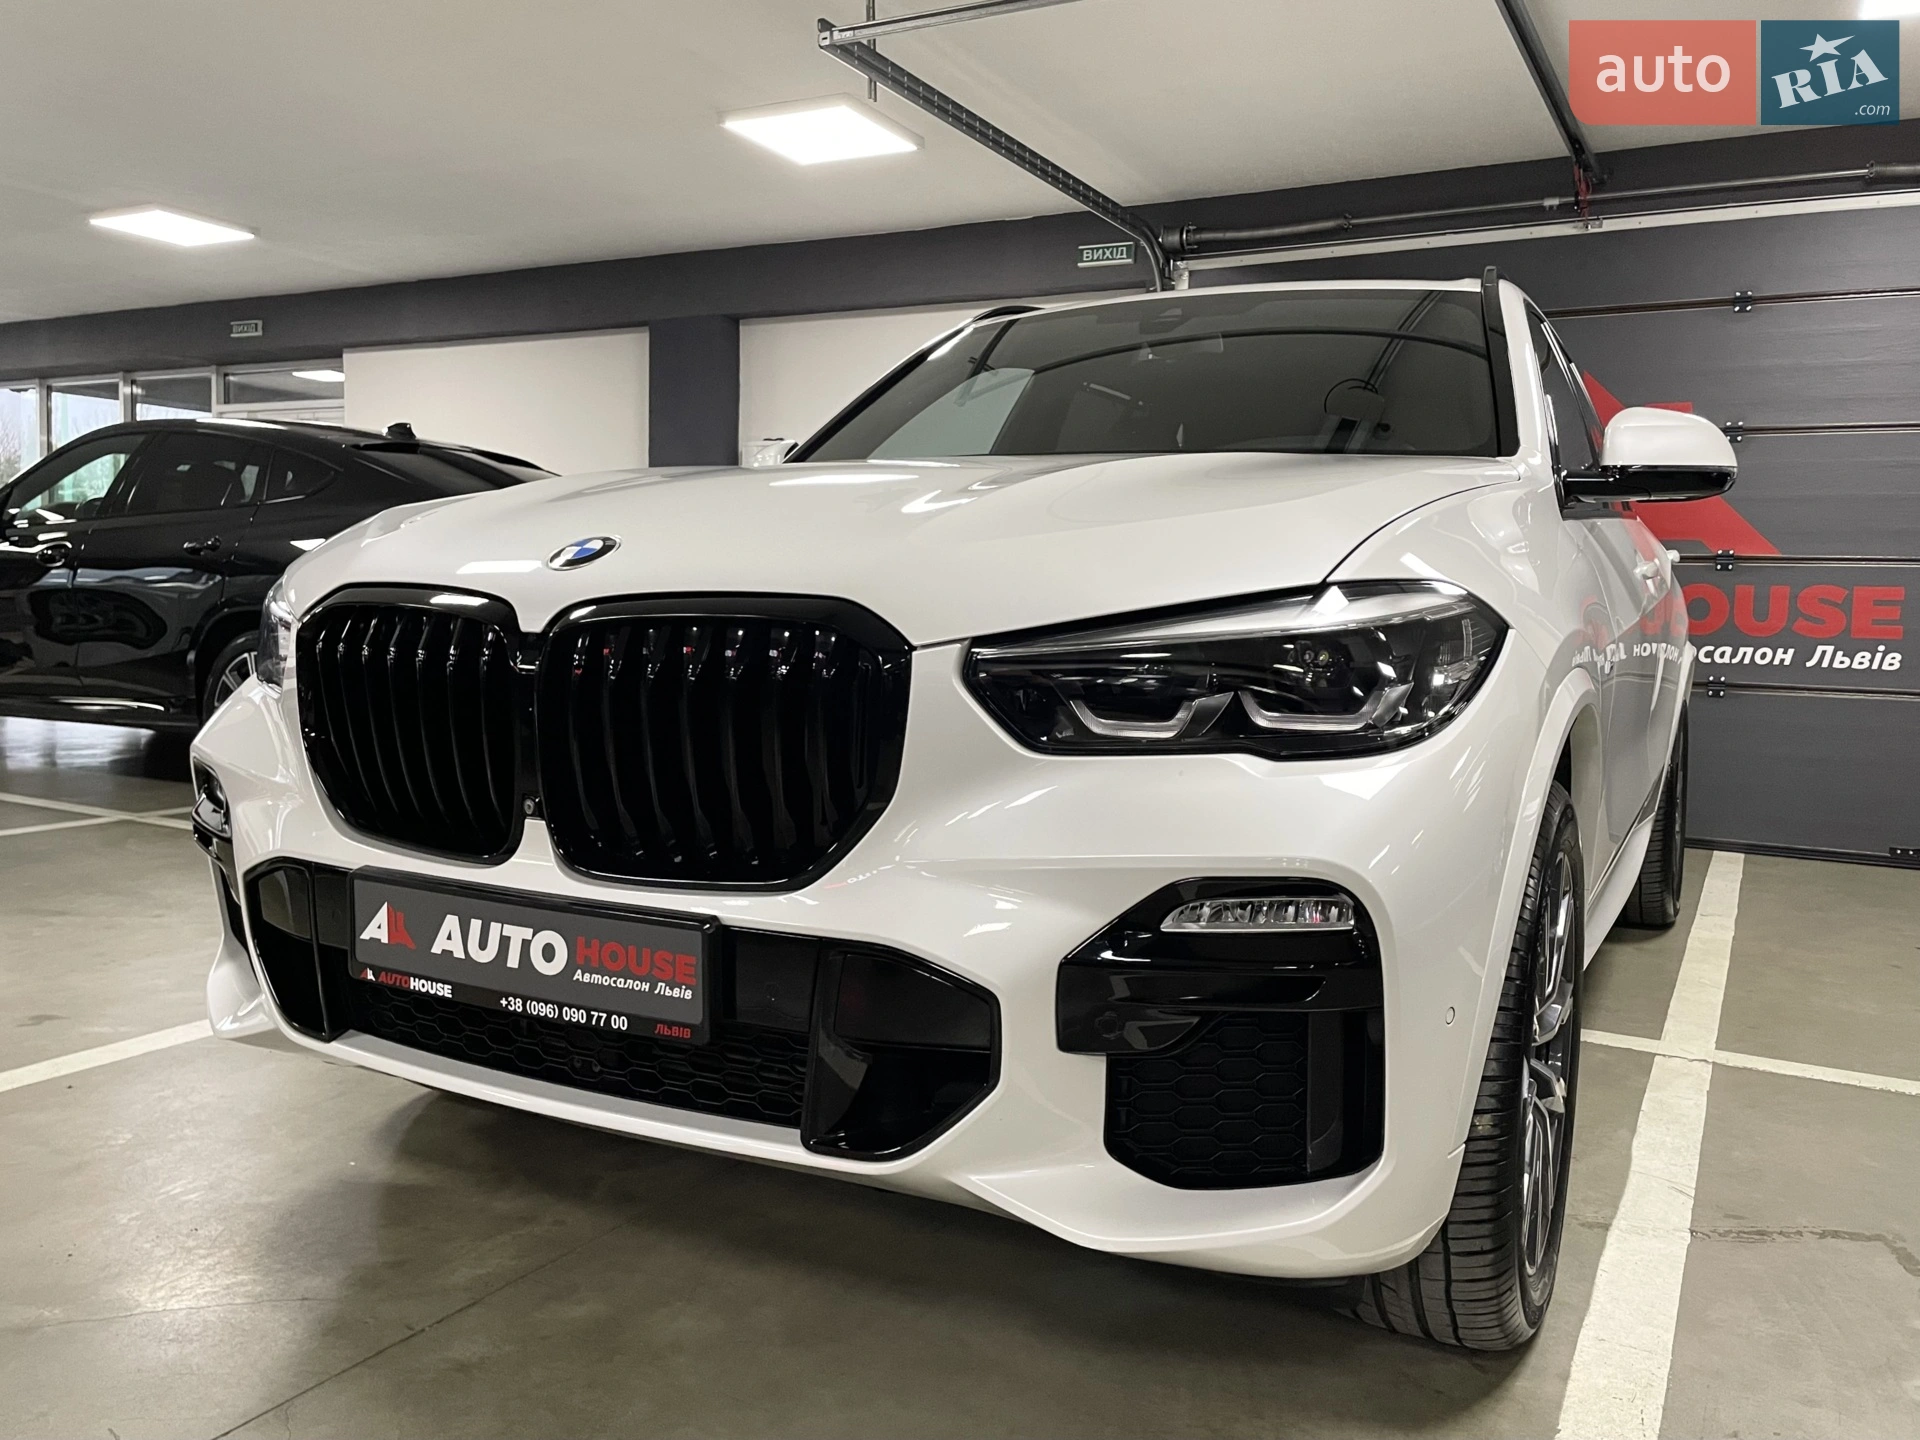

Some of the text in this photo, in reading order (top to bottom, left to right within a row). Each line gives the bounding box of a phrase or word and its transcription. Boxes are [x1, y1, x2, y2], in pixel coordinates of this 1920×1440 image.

[1082, 246, 1127, 261] ВИХІД
[1680, 583, 1906, 640] OUSE
[1690, 642, 1795, 666] салон
[1805, 644, 1903, 671] Львів
[431, 914, 697, 985] AUTO HOUSE
[378, 971, 453, 998] AUTOHOUSE
[573, 968, 693, 1000] Автосалон Львів
[500, 996, 628, 1031] +38 (096) 090 77 00
[655, 1023, 692, 1039] ЛЬВІВ
